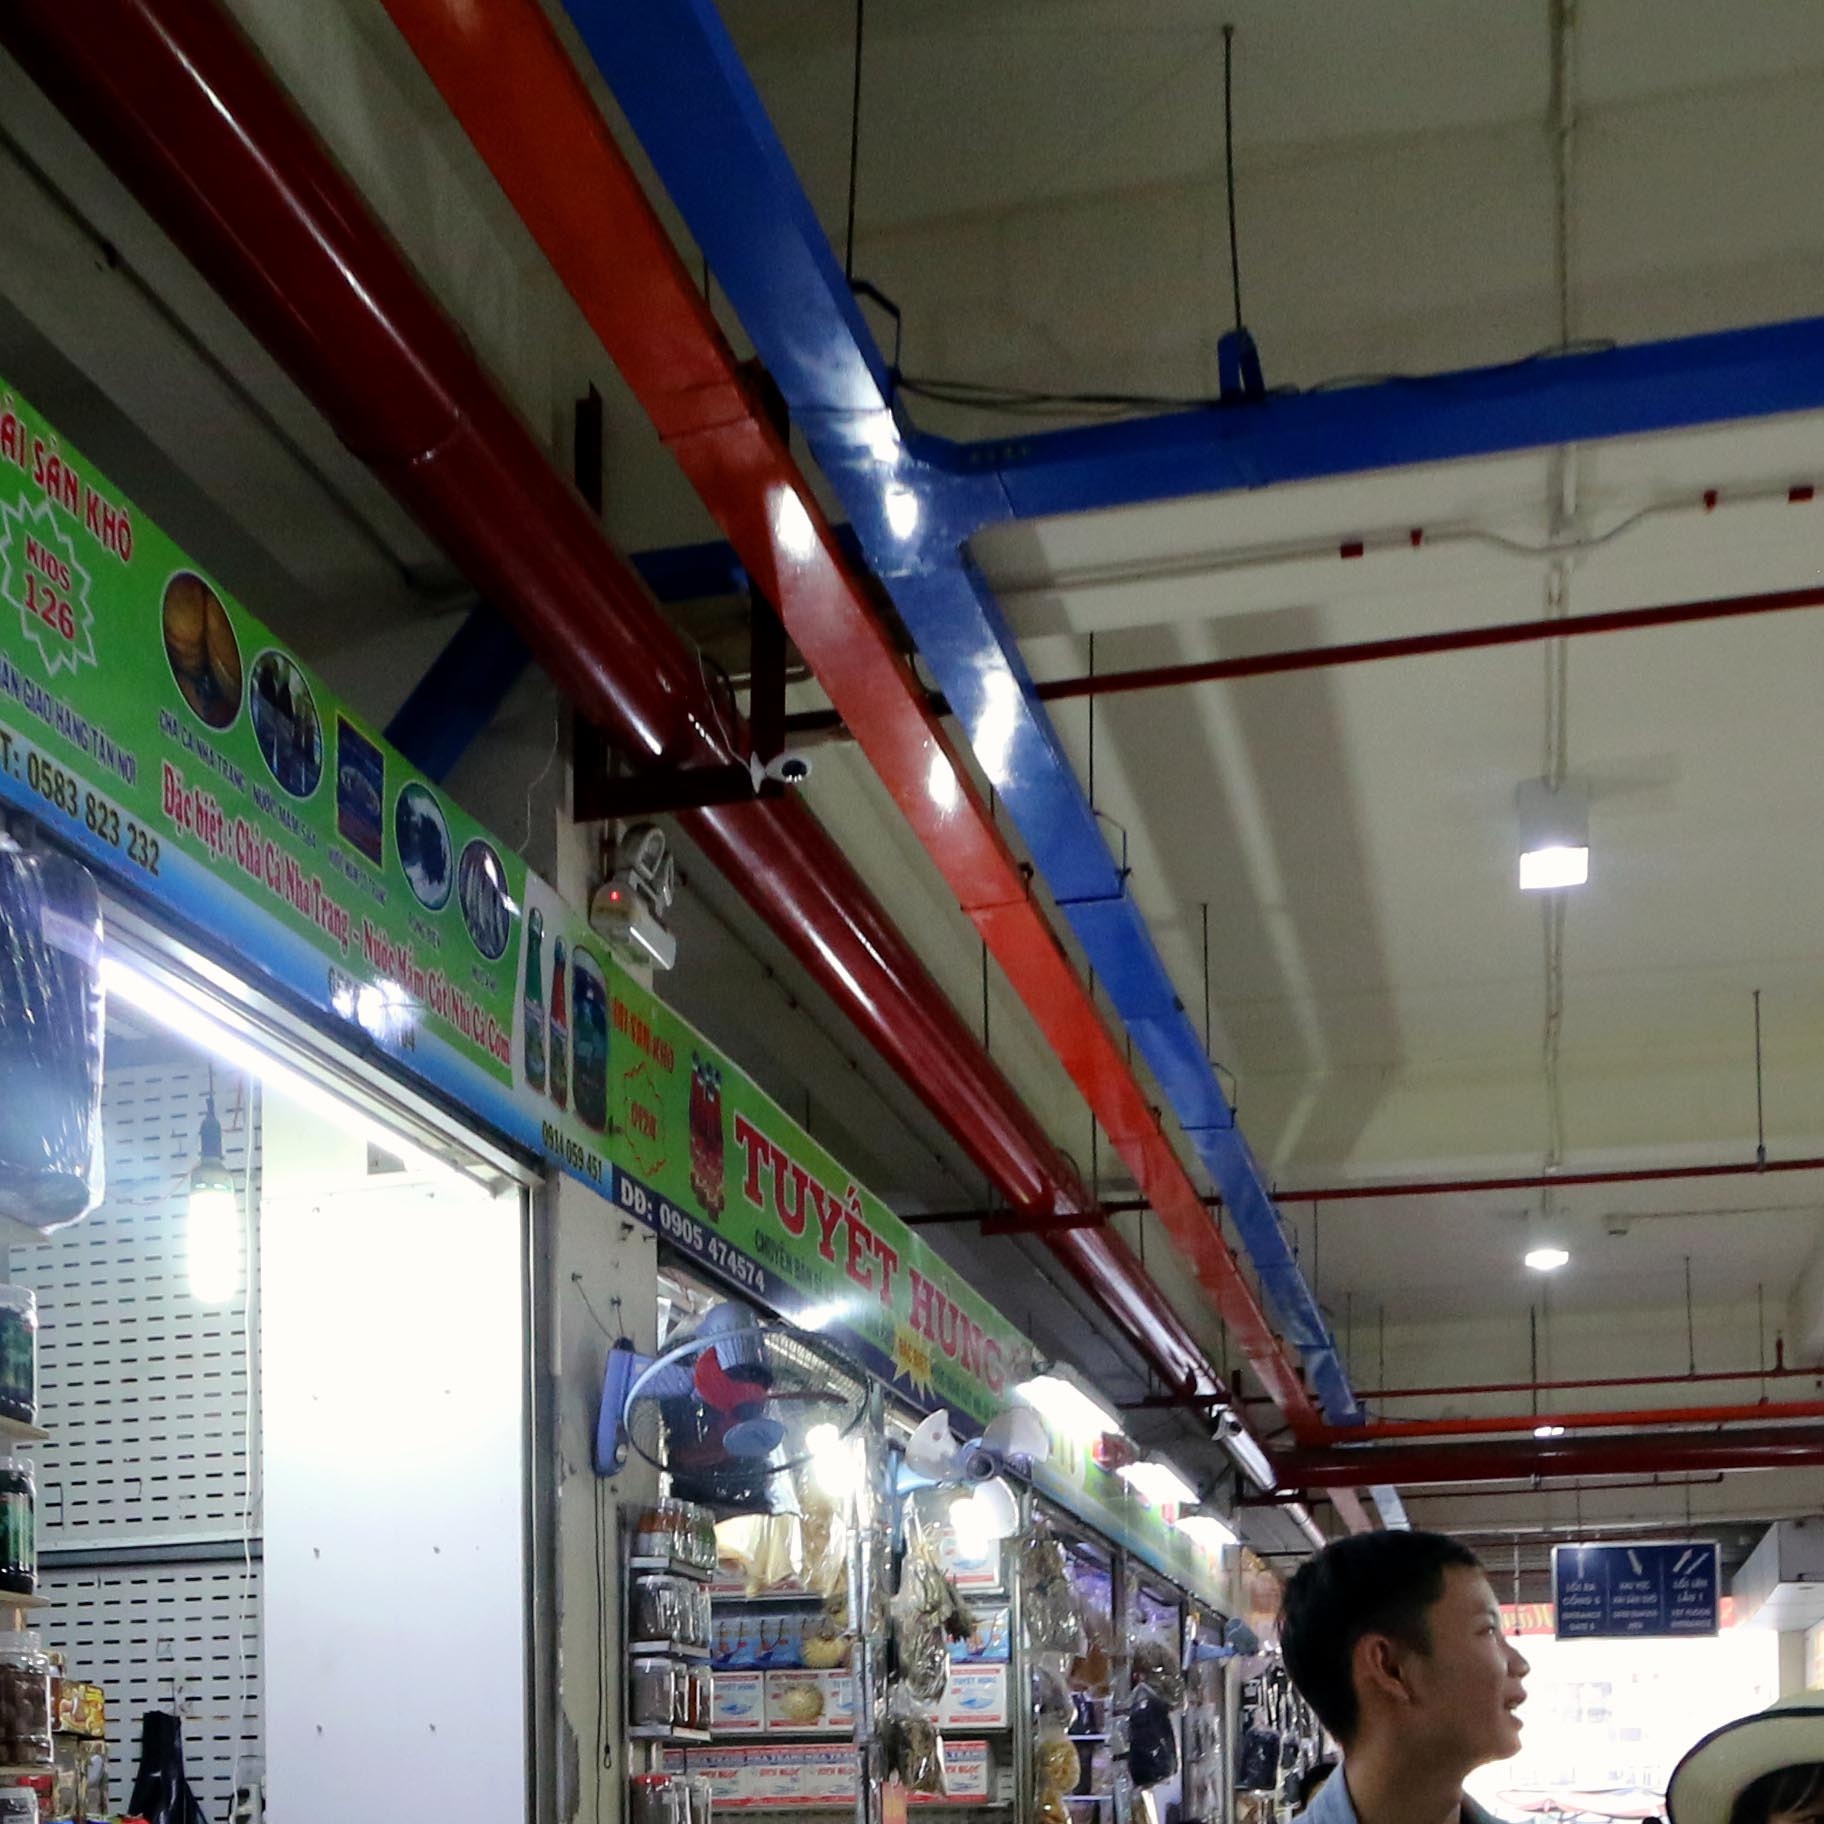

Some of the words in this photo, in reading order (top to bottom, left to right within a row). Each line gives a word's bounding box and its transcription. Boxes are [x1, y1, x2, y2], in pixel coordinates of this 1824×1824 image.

[33, 433, 80, 518] SẢN
[84, 482, 134, 563] KHÔ
[23, 572, 76, 643] 126
[24, 533, 72, 593] KIOS
[26, 748, 78, 820] 0583
[83, 794, 121, 851] 823
[125, 823, 162, 877] 232
[161, 760, 192, 836] Đặc
[284, 855, 312, 916] Nha
[311, 875, 349, 956] Trang
[541, 1119, 565, 1157] 0914
[565, 1136, 586, 1172] 059
[584, 1151, 604, 1185] 451
[658, 1202, 704, 1252] 0905
[706, 1234, 767, 1294] 474574
[734, 1113, 900, 1308] TUYẾT
[907, 1265, 1007, 1399] HÙNG
